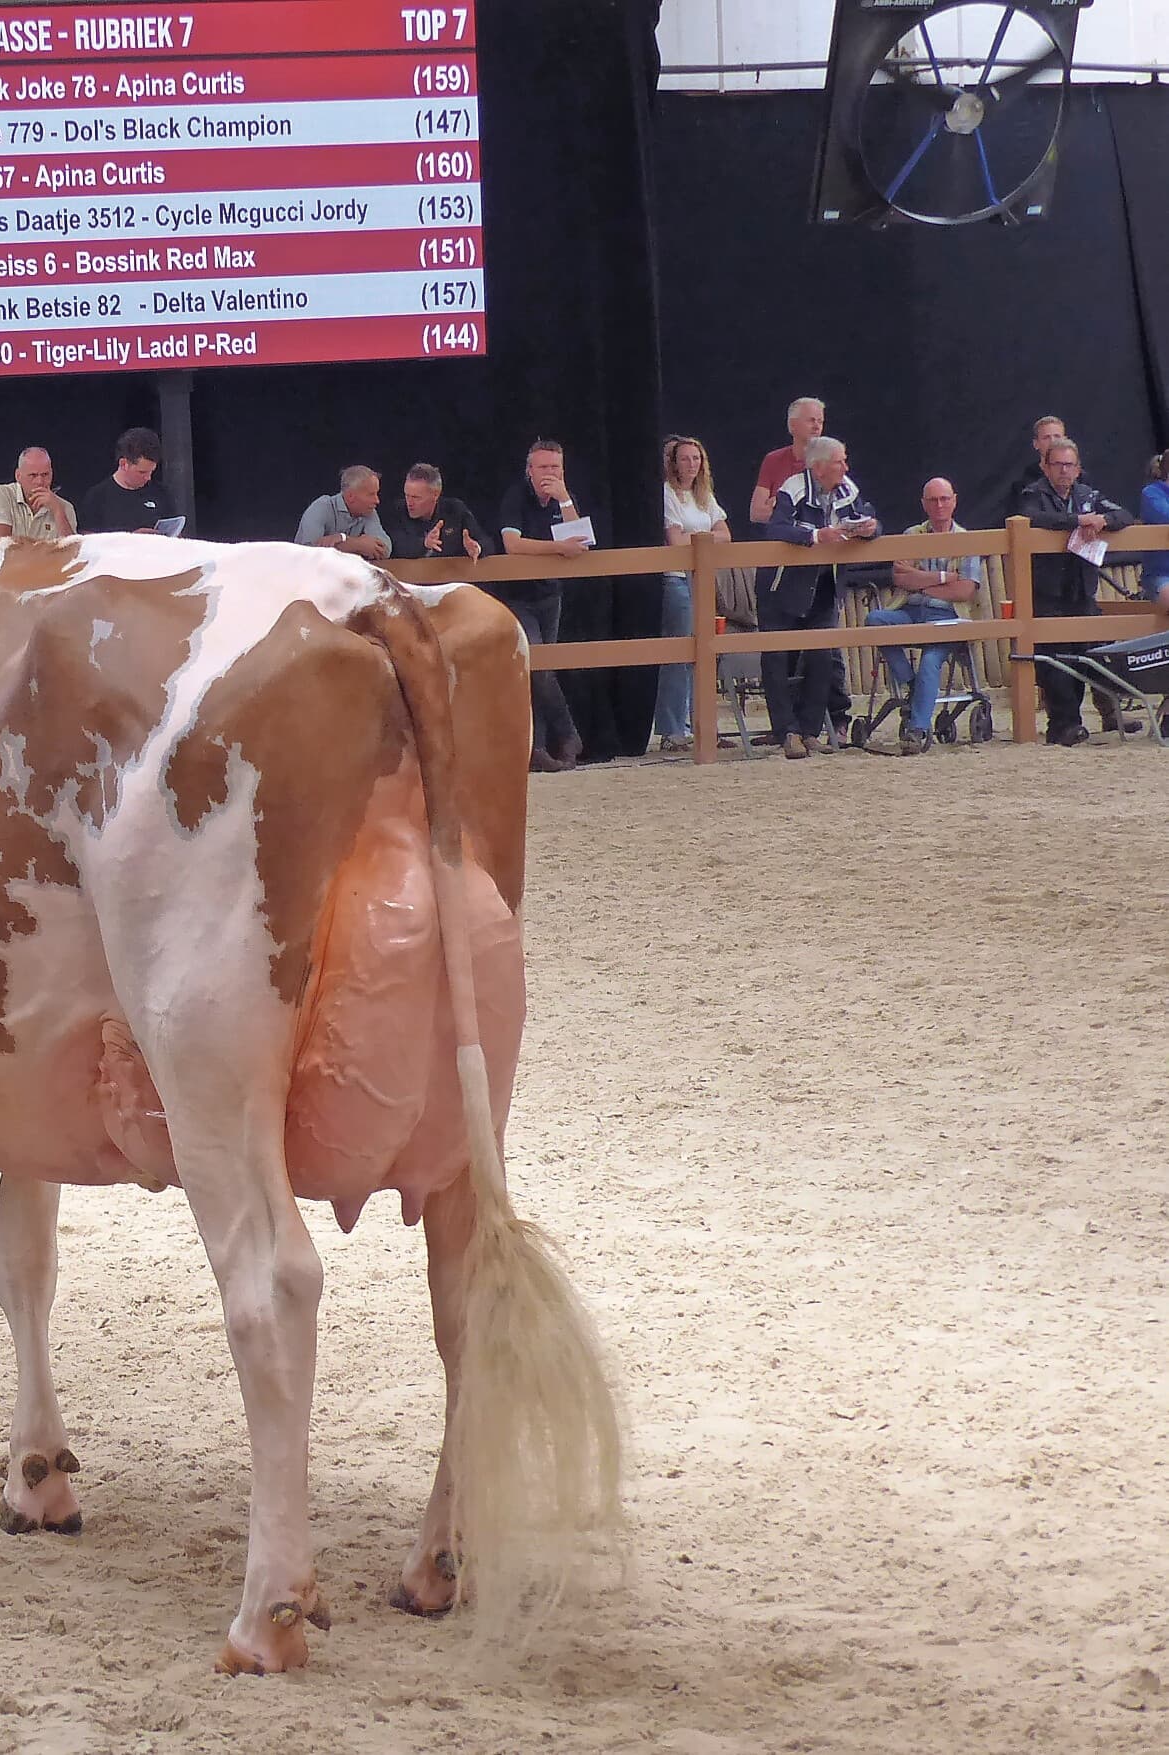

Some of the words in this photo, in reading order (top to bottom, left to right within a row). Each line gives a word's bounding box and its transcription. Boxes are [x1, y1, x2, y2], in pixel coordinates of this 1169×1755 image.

[74, 16, 174, 51] RUBRIEK
[178, 16, 194, 47] 7
[401, 8, 447, 42] TOP
[452, 8, 467, 40] 7
[15, 76, 66, 100] Joke
[71, 75, 97, 99] 78
[115, 73, 176, 103] Apina
[182, 71, 245, 96] Curtis
[413, 65, 470, 95] (159)
[7, 120, 44, 145] 779
[64, 118, 117, 142] Dol's
[123, 116, 181, 141] Black
[187, 114, 292, 143] Champion
[415, 109, 471, 138] (147)
[34, 162, 96, 193] Apina
[102, 161, 166, 186] Curtis
[416, 151, 473, 181] (160)
[16, 207, 81, 236] Daatje
[87, 205, 136, 230] 3512
[155, 203, 213, 232] Cycle
[219, 199, 304, 230] Mcgucci
[310, 197, 368, 226] Jordy
[418, 194, 474, 224] (153)
[44, 252, 57, 275] 6
[75, 248, 161, 274] Bossink
[166, 246, 208, 271] Red
[213, 245, 256, 269] Max
[419, 237, 476, 267] (151)
[26, 295, 91, 321] Betsie
[97, 293, 122, 317] 82
[153, 290, 206, 315] Delta
[210, 287, 308, 313] Valentino
[421, 280, 477, 309] (157)
[31, 337, 131, 368] Tiger-Lily
[137, 334, 188, 360] Ladd
[194, 331, 257, 357] P-Red
[422, 322, 479, 352] (144)
[1127, 649, 1162, 665] Proud
